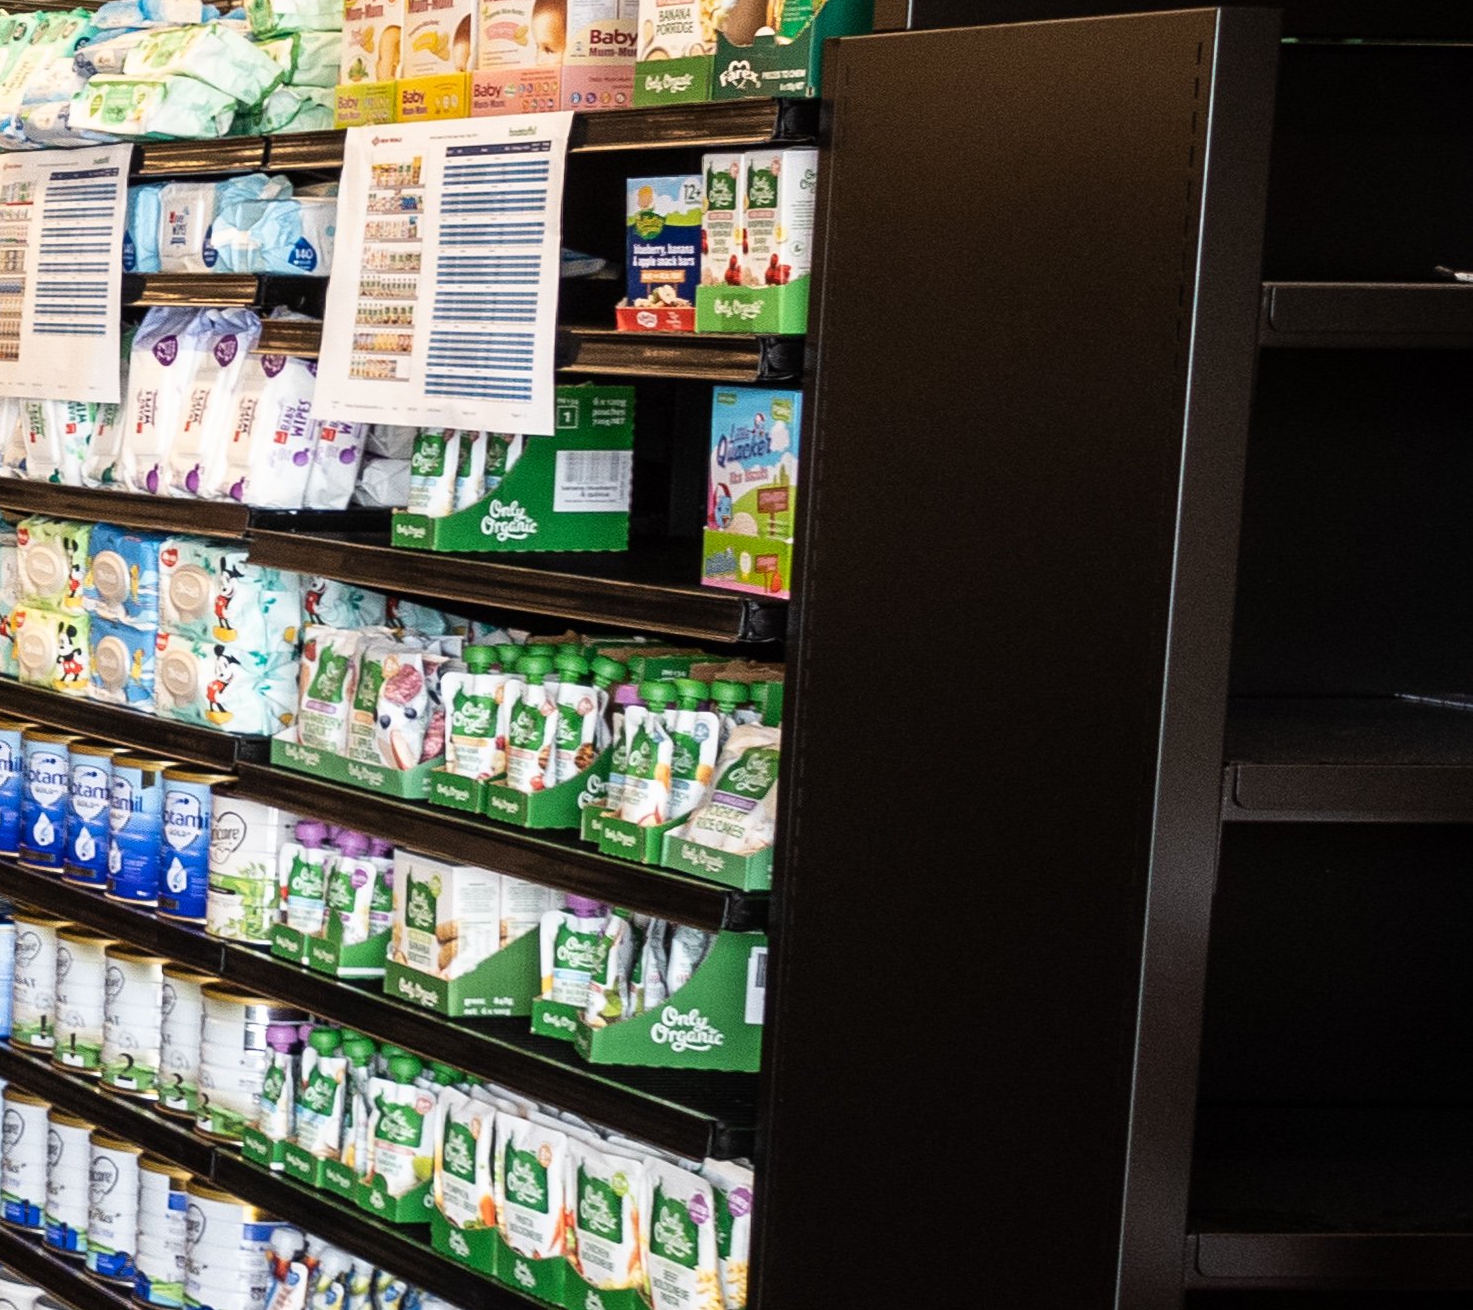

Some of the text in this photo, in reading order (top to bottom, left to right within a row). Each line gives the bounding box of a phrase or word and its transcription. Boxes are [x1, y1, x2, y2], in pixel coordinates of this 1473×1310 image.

[658, 6, 692, 23] BANANA
[656, 22, 695, 36] PORRIDGE
[589, 29, 638, 48] Baby
[589, 47, 638, 59] Mum-Mu
[720, 66, 760, 90] Farex
[402, 89, 426, 104] Baby
[473, 82, 502, 99] Baby
[294, 248, 314, 260] 140
[290, 399, 312, 437] WIPES
[563, 410, 571, 424] 1
[488, 499, 527, 524] Only
[480, 514, 538, 542] Organic
[661, 1005, 709, 1031] Only
[650, 1022, 724, 1052] Organic
